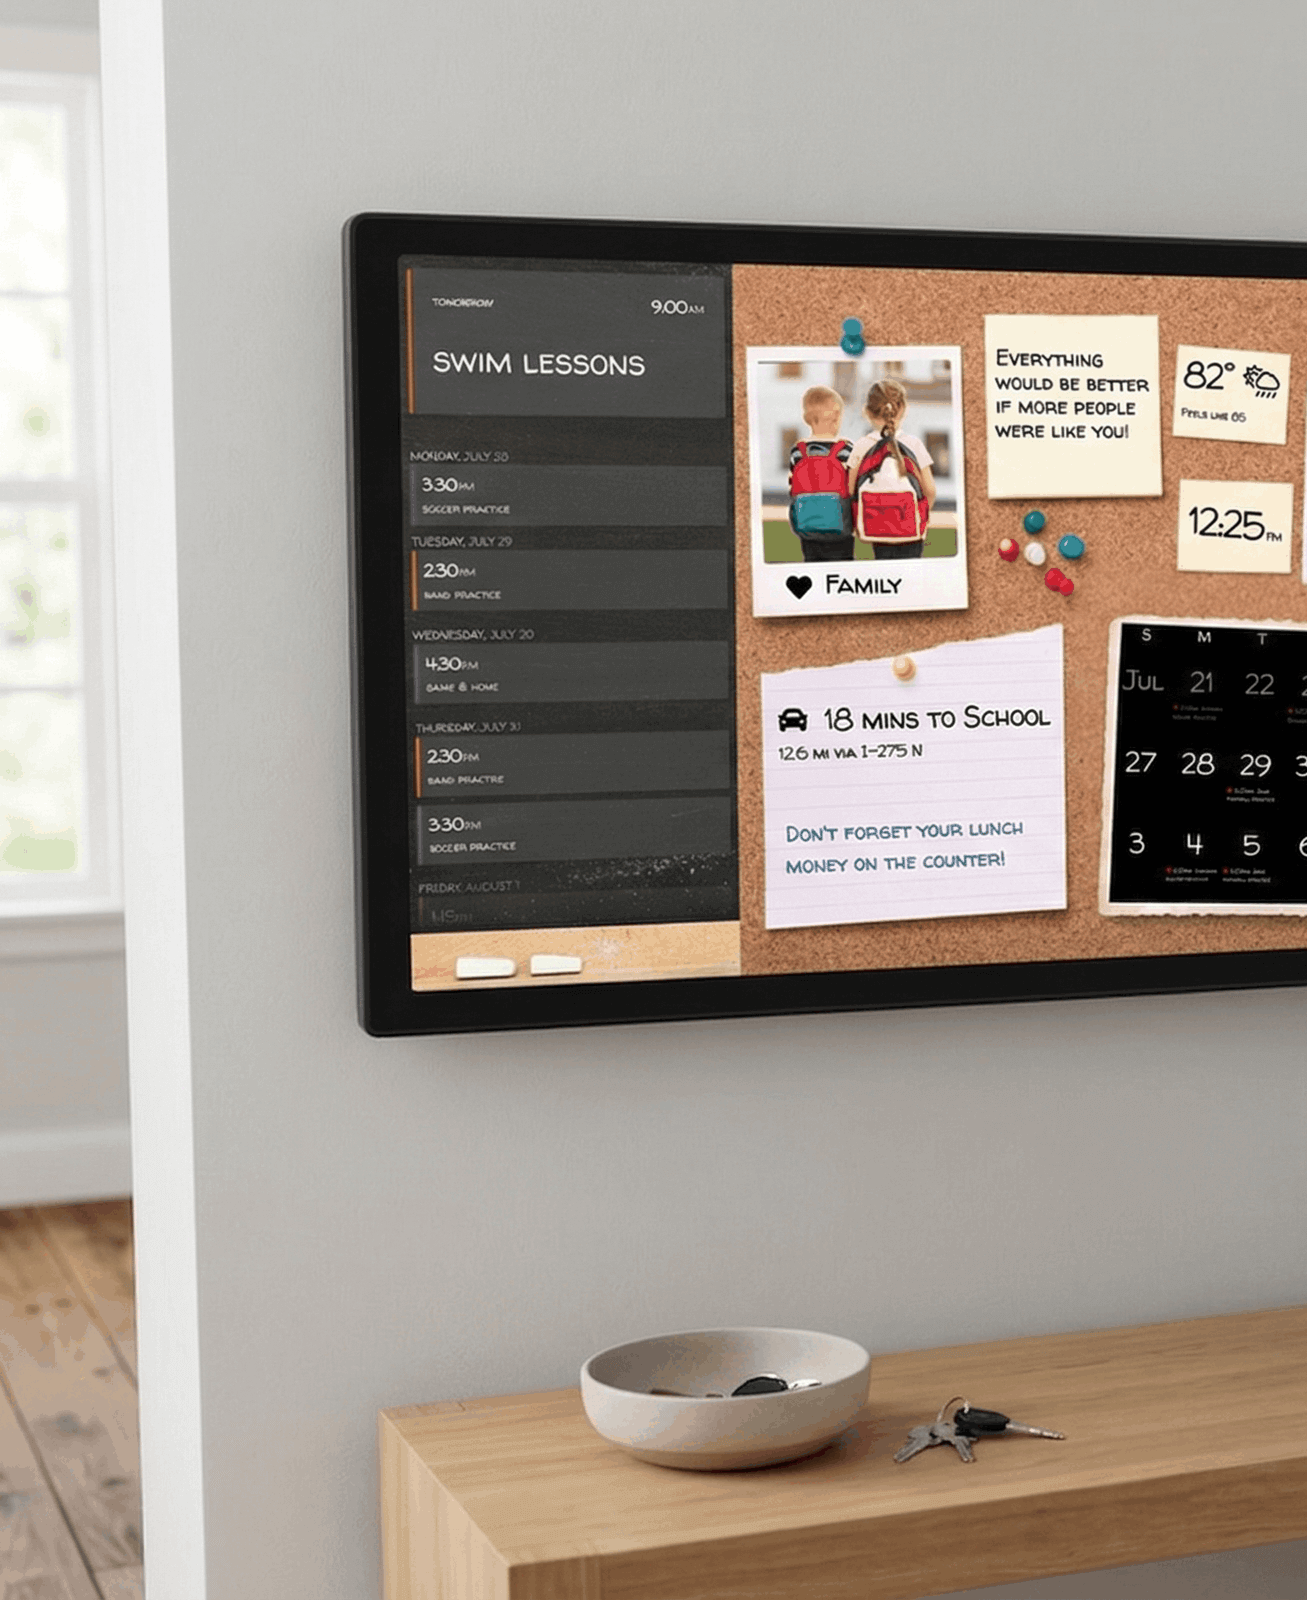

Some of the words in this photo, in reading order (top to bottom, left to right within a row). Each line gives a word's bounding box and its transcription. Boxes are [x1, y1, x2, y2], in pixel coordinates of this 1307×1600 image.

[434, 352, 511, 373] SWIM
[524, 354, 645, 375] LESSONS
[997, 349, 1103, 368] EVERYTHING
[995, 377, 1053, 390] WOULD
[1060, 378, 1080, 391] BE
[1087, 379, 1149, 392] BETTER
[997, 401, 1011, 413] IF
[1019, 401, 1067, 414] MORE
[1074, 402, 1135, 415] PEOPLE
[995, 425, 1044, 438] WERE
[1052, 426, 1086, 438] LIKE
[1091, 425, 1128, 439] YOU!
[468, 537, 495, 546] JULY
[827, 574, 902, 594] FAMILY
[1142, 628, 1151, 641] S
[1198, 631, 1211, 642] M
[1257, 633, 1267, 645] T
[1122, 669, 1164, 691] JUL
[1191, 671, 1212, 692] 21
[1245, 673, 1274, 695] 22
[825, 708, 853, 731] 18
[863, 712, 919, 729] MINS
[927, 711, 955, 728] TO
[964, 705, 1051, 728] SCHOOL
[813, 749, 829, 759] MI
[834, 748, 857, 758] VIA
[912, 744, 922, 756] N
[1126, 751, 1157, 772] 27
[1182, 753, 1215, 775] 28
[1240, 754, 1271, 777] 29
[787, 826, 838, 842] DON'T
[844, 826, 912, 840] FORGET
[916, 824, 963, 837] YOUR
[970, 822, 1023, 836] LUNCH
[1130, 832, 1145, 854] 3
[1187, 834, 1203, 855] 4
[1244, 835, 1260, 856] 5
[786, 859, 848, 873] MONEY
[854, 858, 877, 871] ON
[884, 857, 916, 870] THE
[923, 851, 1005, 868] COUNTER!
